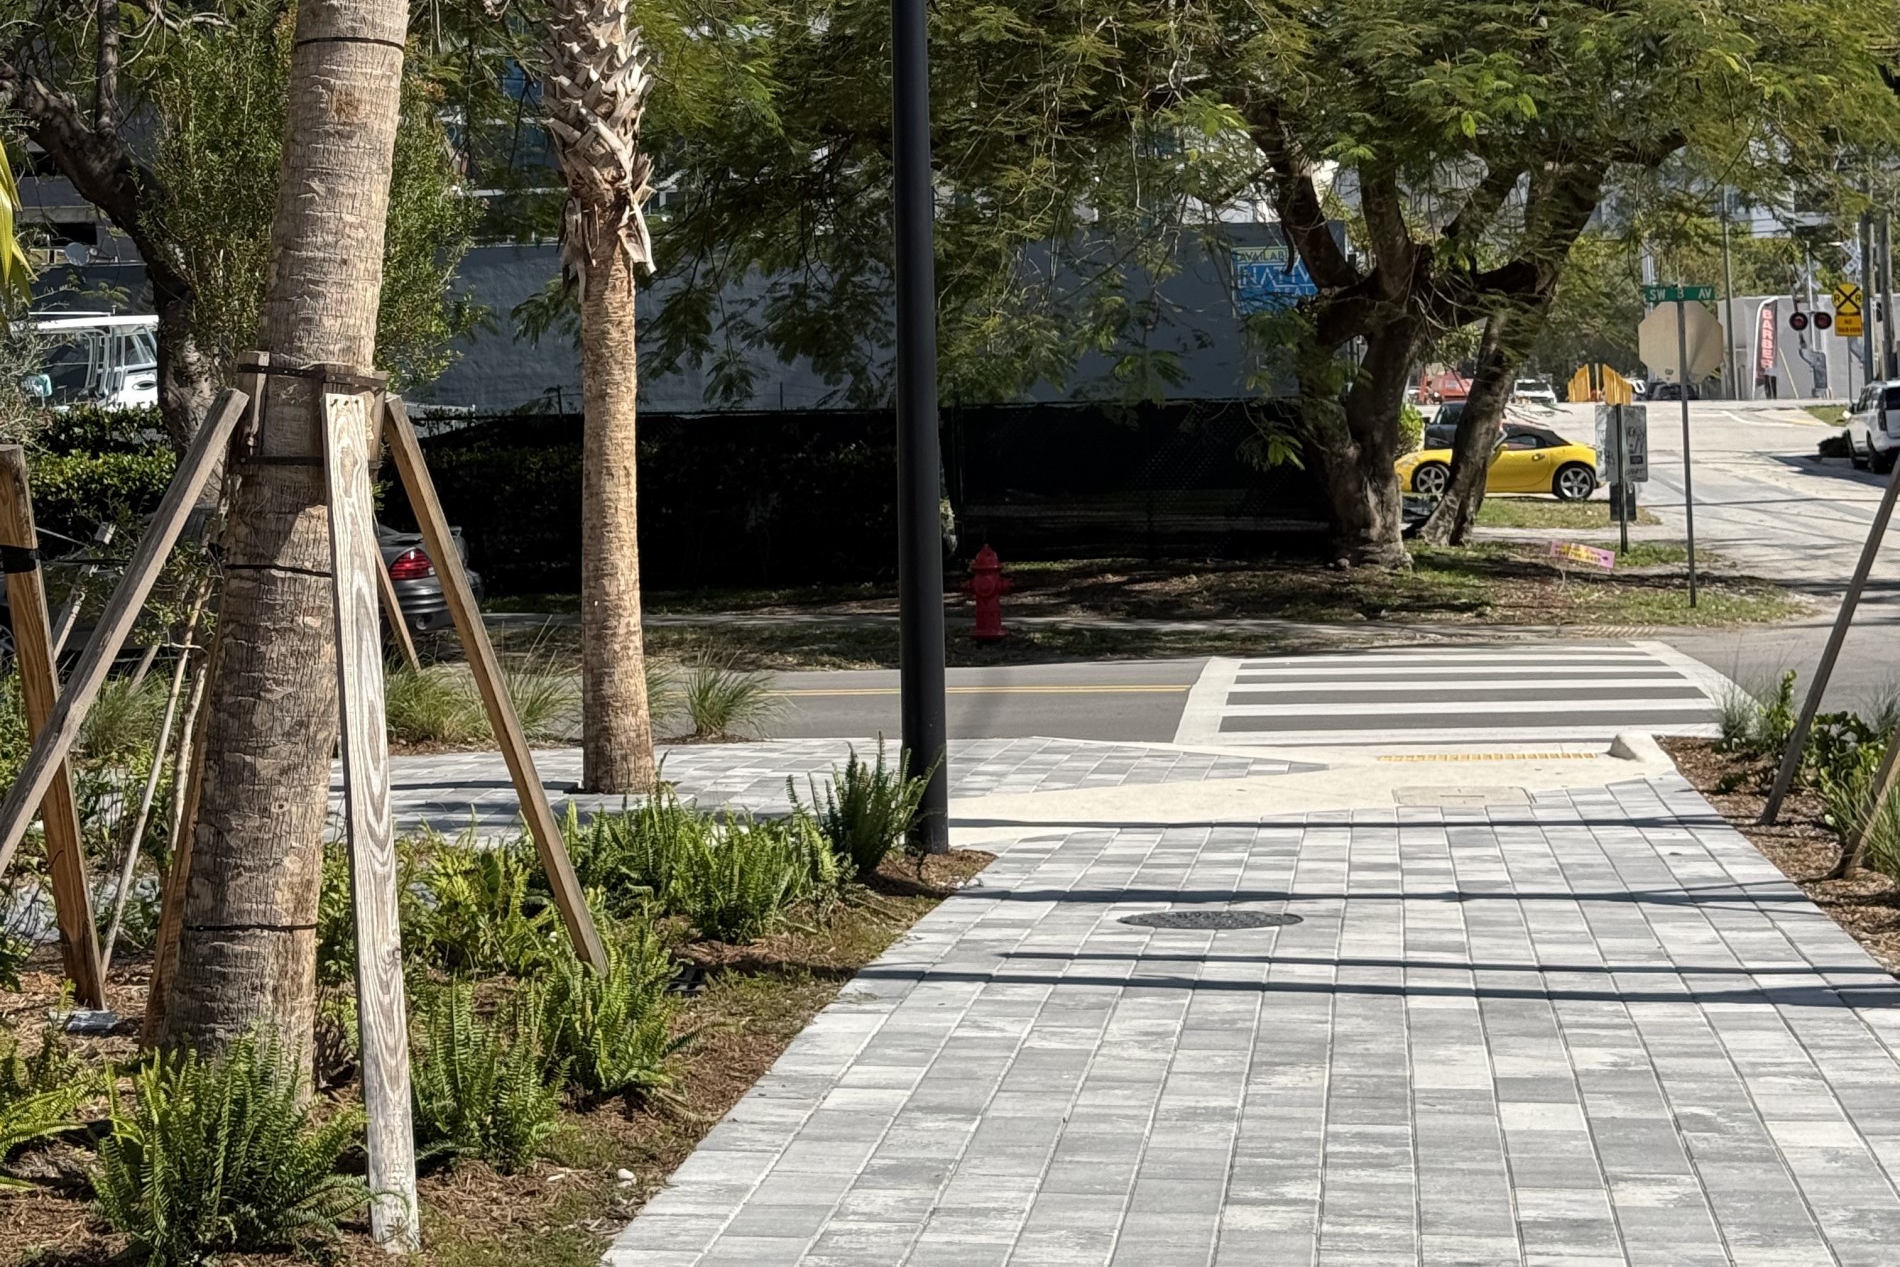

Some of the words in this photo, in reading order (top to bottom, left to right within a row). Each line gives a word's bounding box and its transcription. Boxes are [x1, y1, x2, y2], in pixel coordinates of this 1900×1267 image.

[1240, 251, 1287, 262] AVAILAB
[1242, 266, 1310, 284] NATIV
[1649, 288, 1666, 301] SW
[1698, 287, 1712, 299] AV
[1833, 294, 1840, 303] R
[1855, 294, 1862, 303] R
[1761, 309, 1774, 369] BARBER
